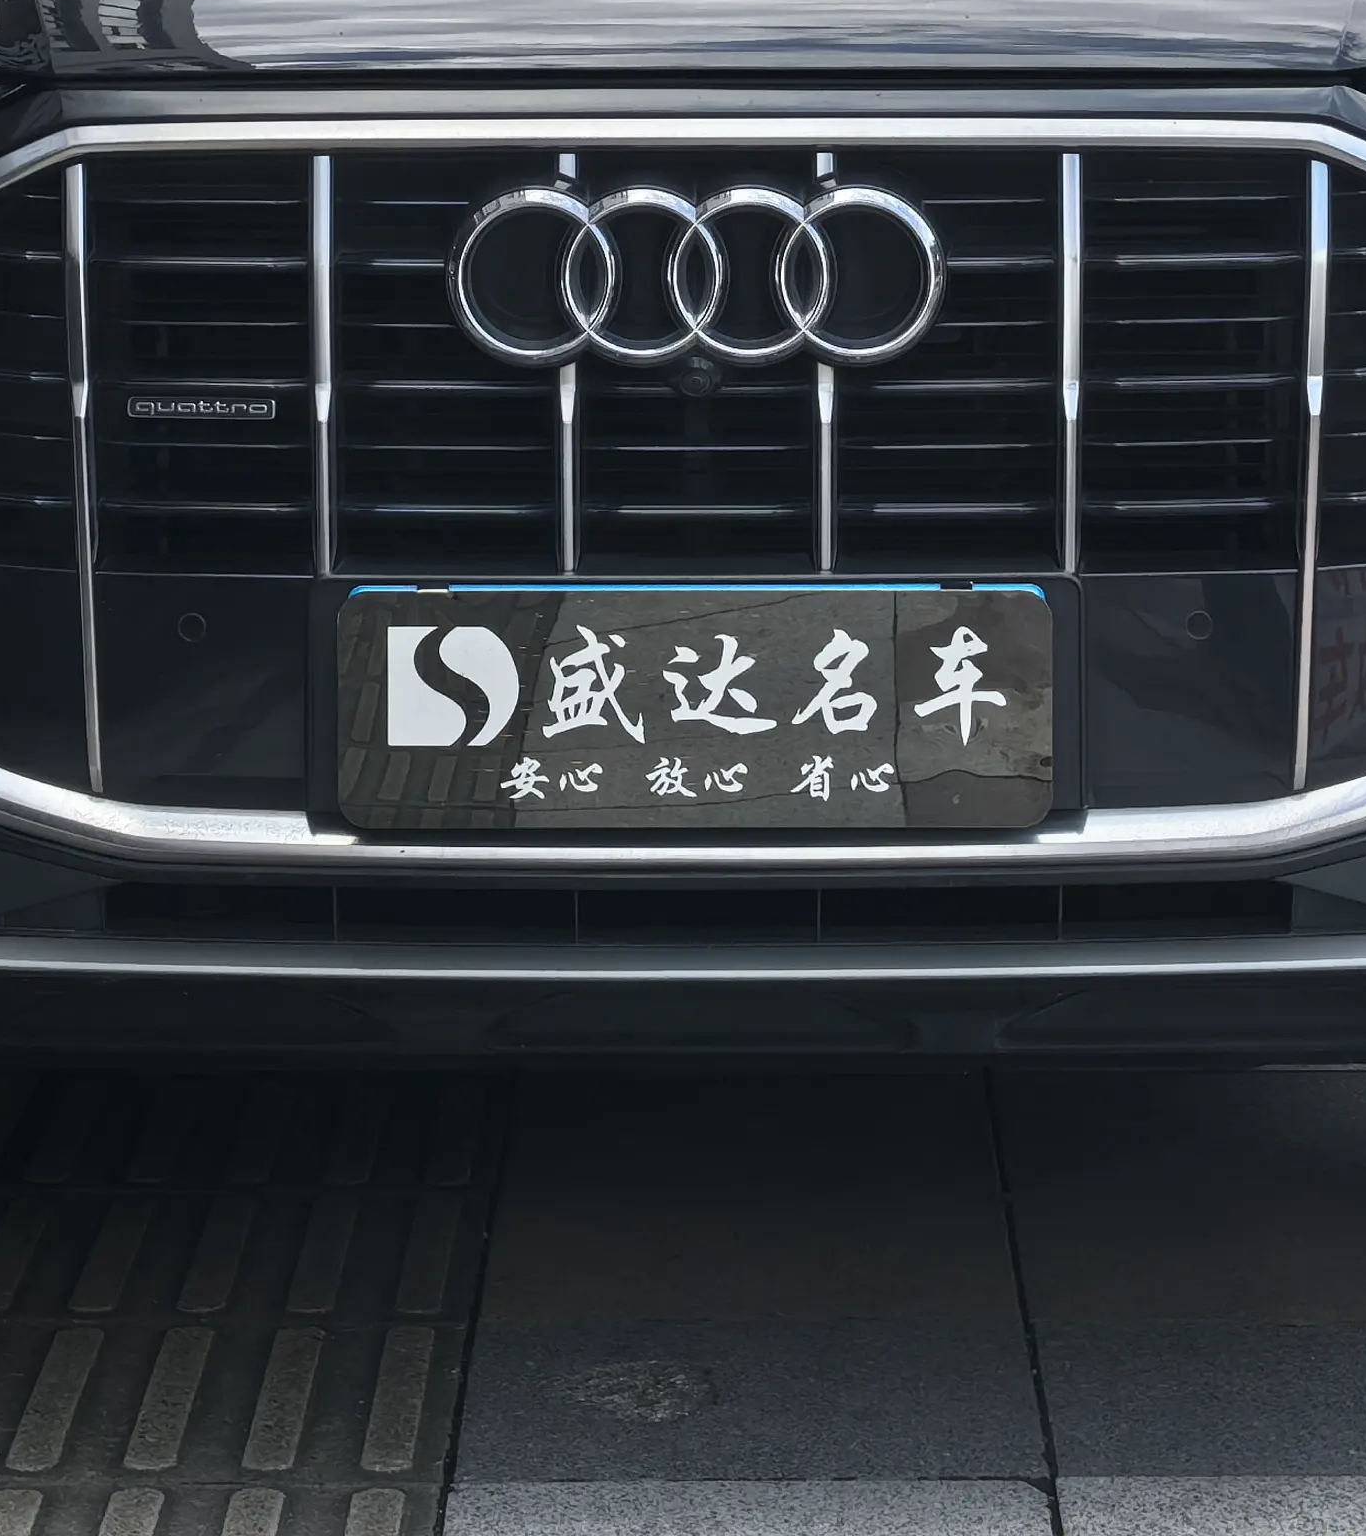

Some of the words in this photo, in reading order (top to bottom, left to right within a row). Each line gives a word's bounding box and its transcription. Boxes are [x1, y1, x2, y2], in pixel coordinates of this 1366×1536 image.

[135, 401, 268, 415] quattro
[542, 624, 1007, 746] 盛达名车
[501, 757, 603, 800] 安心
[646, 757, 748, 798] 放心
[791, 755, 895, 802] 省心
